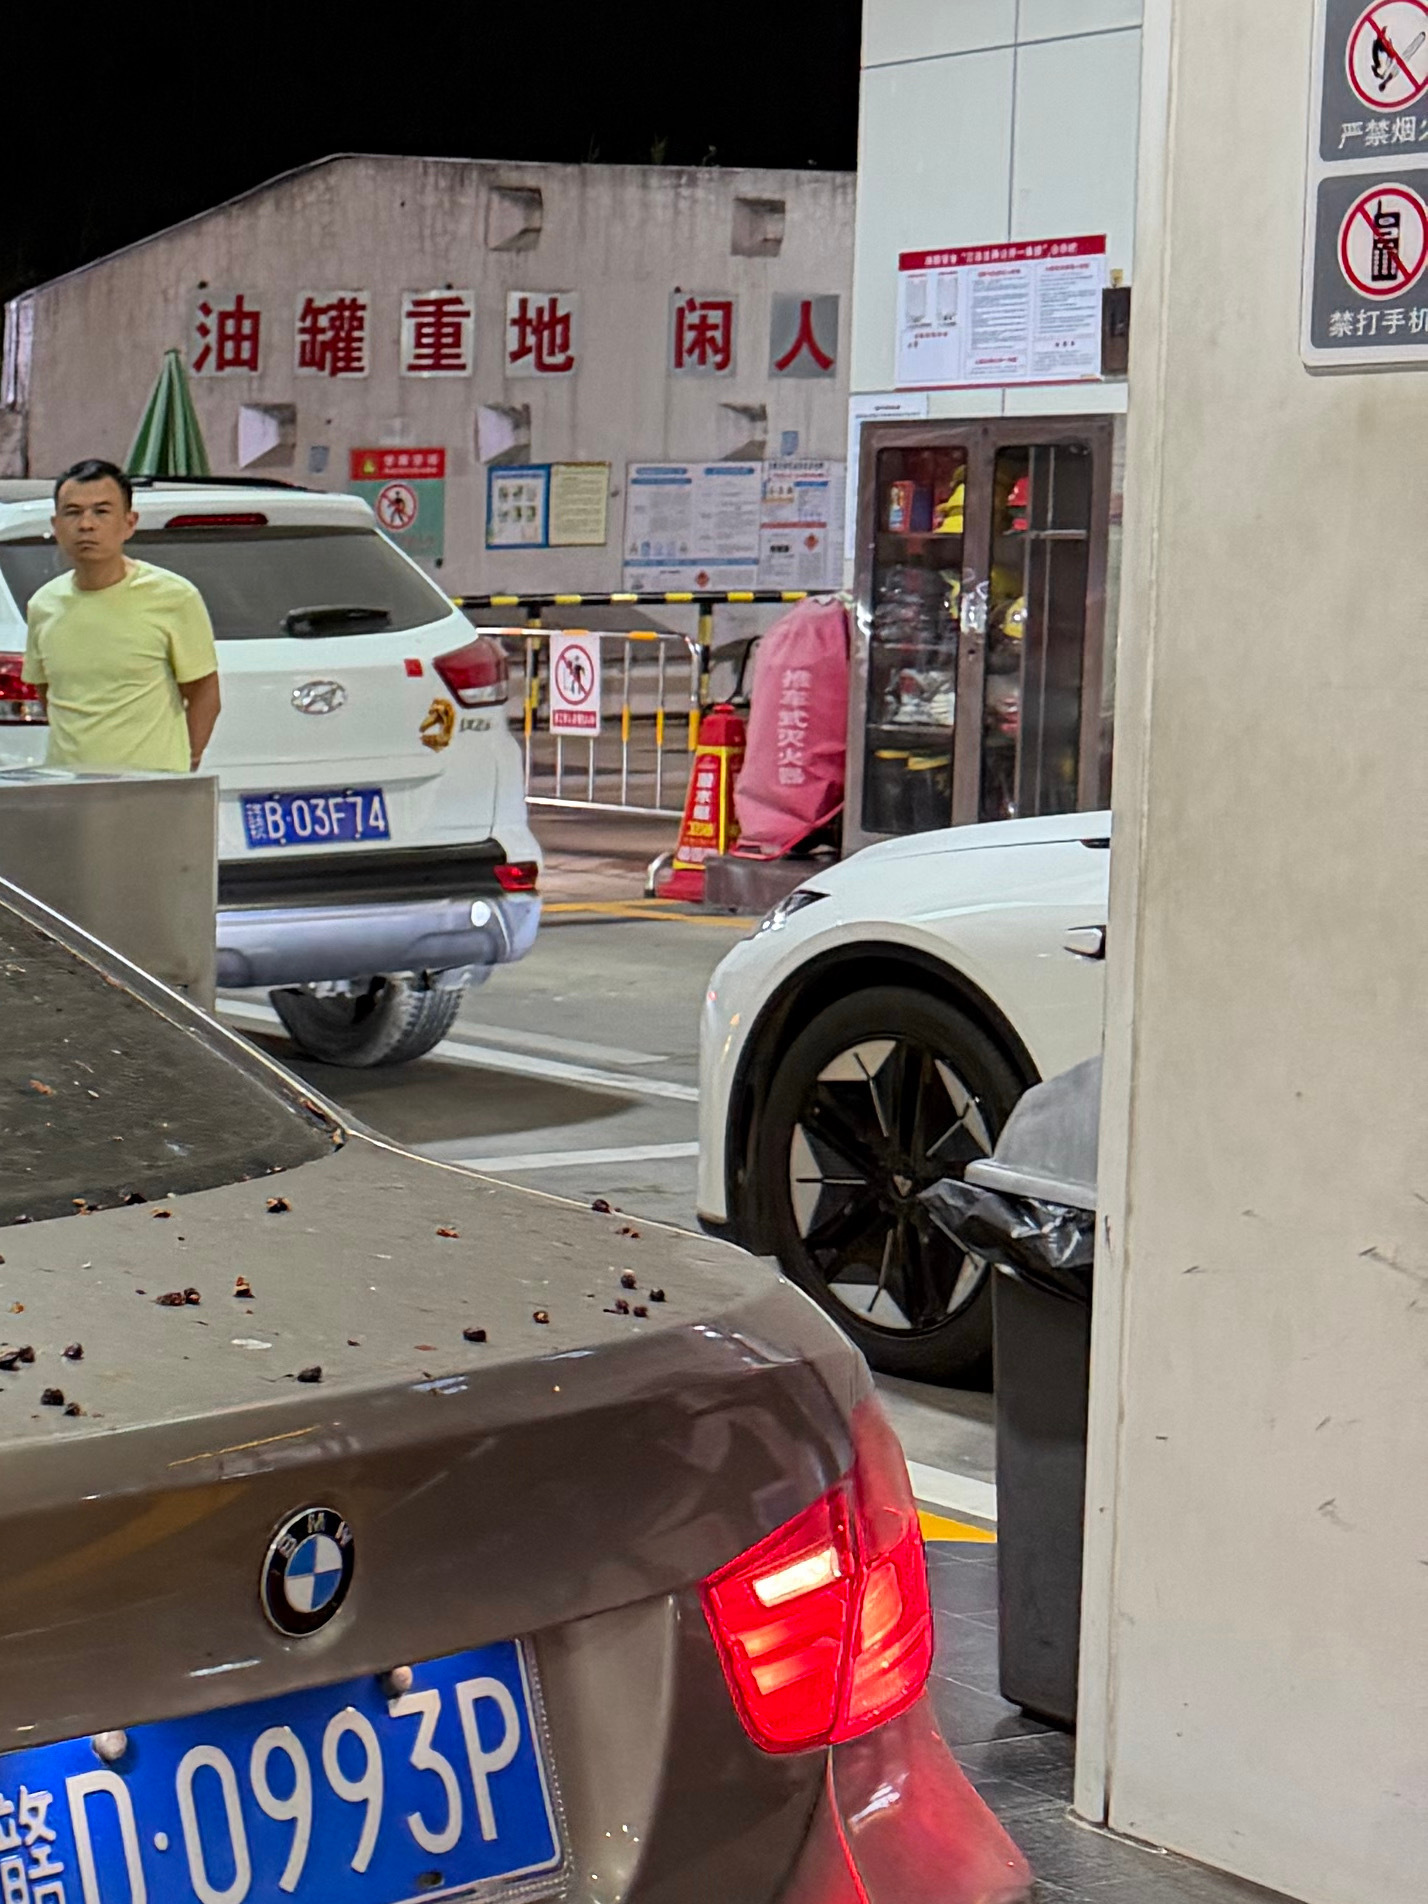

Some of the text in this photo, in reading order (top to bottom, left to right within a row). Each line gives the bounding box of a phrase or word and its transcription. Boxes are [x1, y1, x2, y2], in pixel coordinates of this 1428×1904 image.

[1337, 115, 1428, 149] 严禁烟
[192, 294, 575, 377] 油罐重地
[674, 297, 834, 372] 闲人
[276, 1512, 352, 1560] BMW
